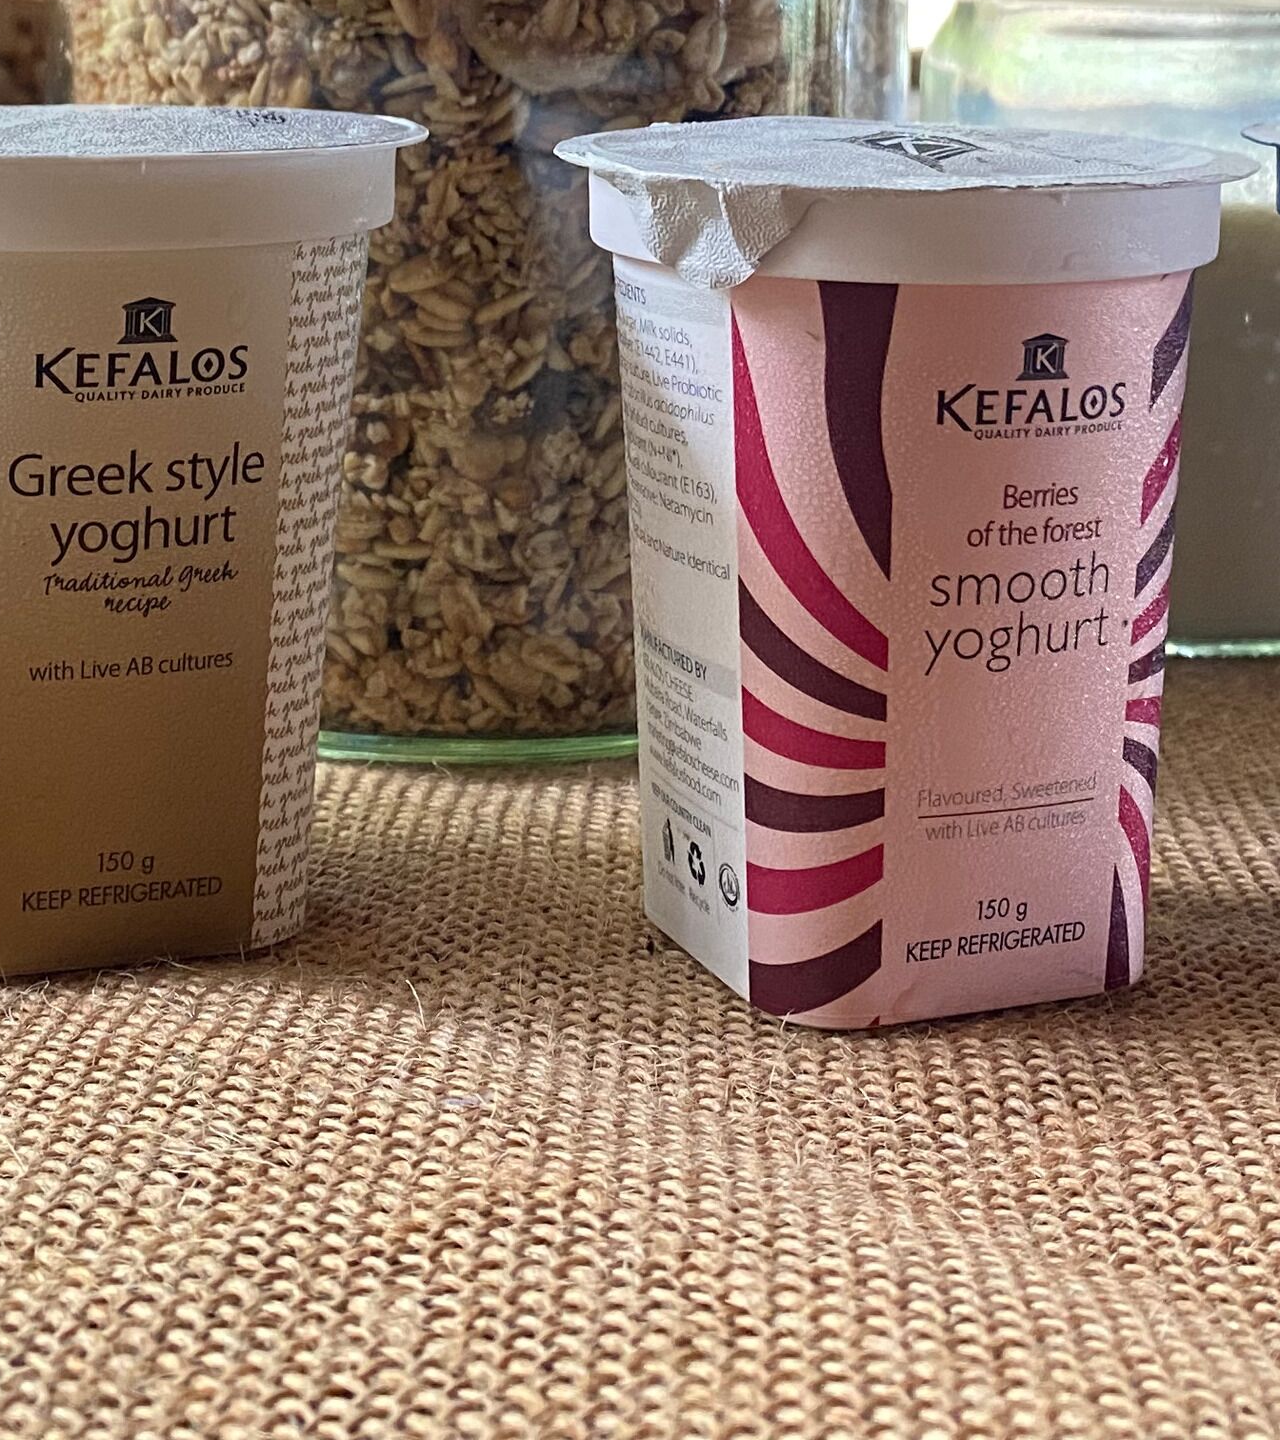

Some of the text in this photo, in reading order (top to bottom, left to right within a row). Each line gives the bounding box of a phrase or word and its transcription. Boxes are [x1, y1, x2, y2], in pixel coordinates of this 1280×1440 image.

[140, 307, 164, 336] K
[34, 345, 249, 395] KEFALOS
[1036, 343, 1059, 374] K
[74, 382, 246, 403] QUALITY DAIRY PRODUCE
[671, 375, 722, 402] Probiotic
[936, 382, 1126, 432] KEFALOS
[974, 421, 1123, 441] QUALITY DAIRY PRODUCE
[9, 441, 265, 502] Greek style
[679, 476, 718, 504] (E163),
[1003, 482, 1079, 510] Berries
[659, 491, 714, 526] Natamycin
[50, 505, 237, 567] yoghurt
[967, 517, 1102, 548] of the forest
[43, 565, 174, 595] Traditional
[686, 552, 730, 580] Identical
[929, 550, 1109, 607] smooth
[104, 593, 172, 617] recipe
[925, 607, 1109, 676] yoghurt
[29, 650, 233, 682] with Live AB cultures
[694, 661, 707, 681] BY
[918, 771, 1097, 808] Flavoured, Sweetened
[925, 810, 1086, 841] with Live AB cultures
[97, 851, 155, 874] 150 g
[22, 876, 223, 912] KEEP REFRIGERATED
[977, 897, 1028, 922] 150 g
[906, 921, 1086, 963] KEEP REFRIGERATED
